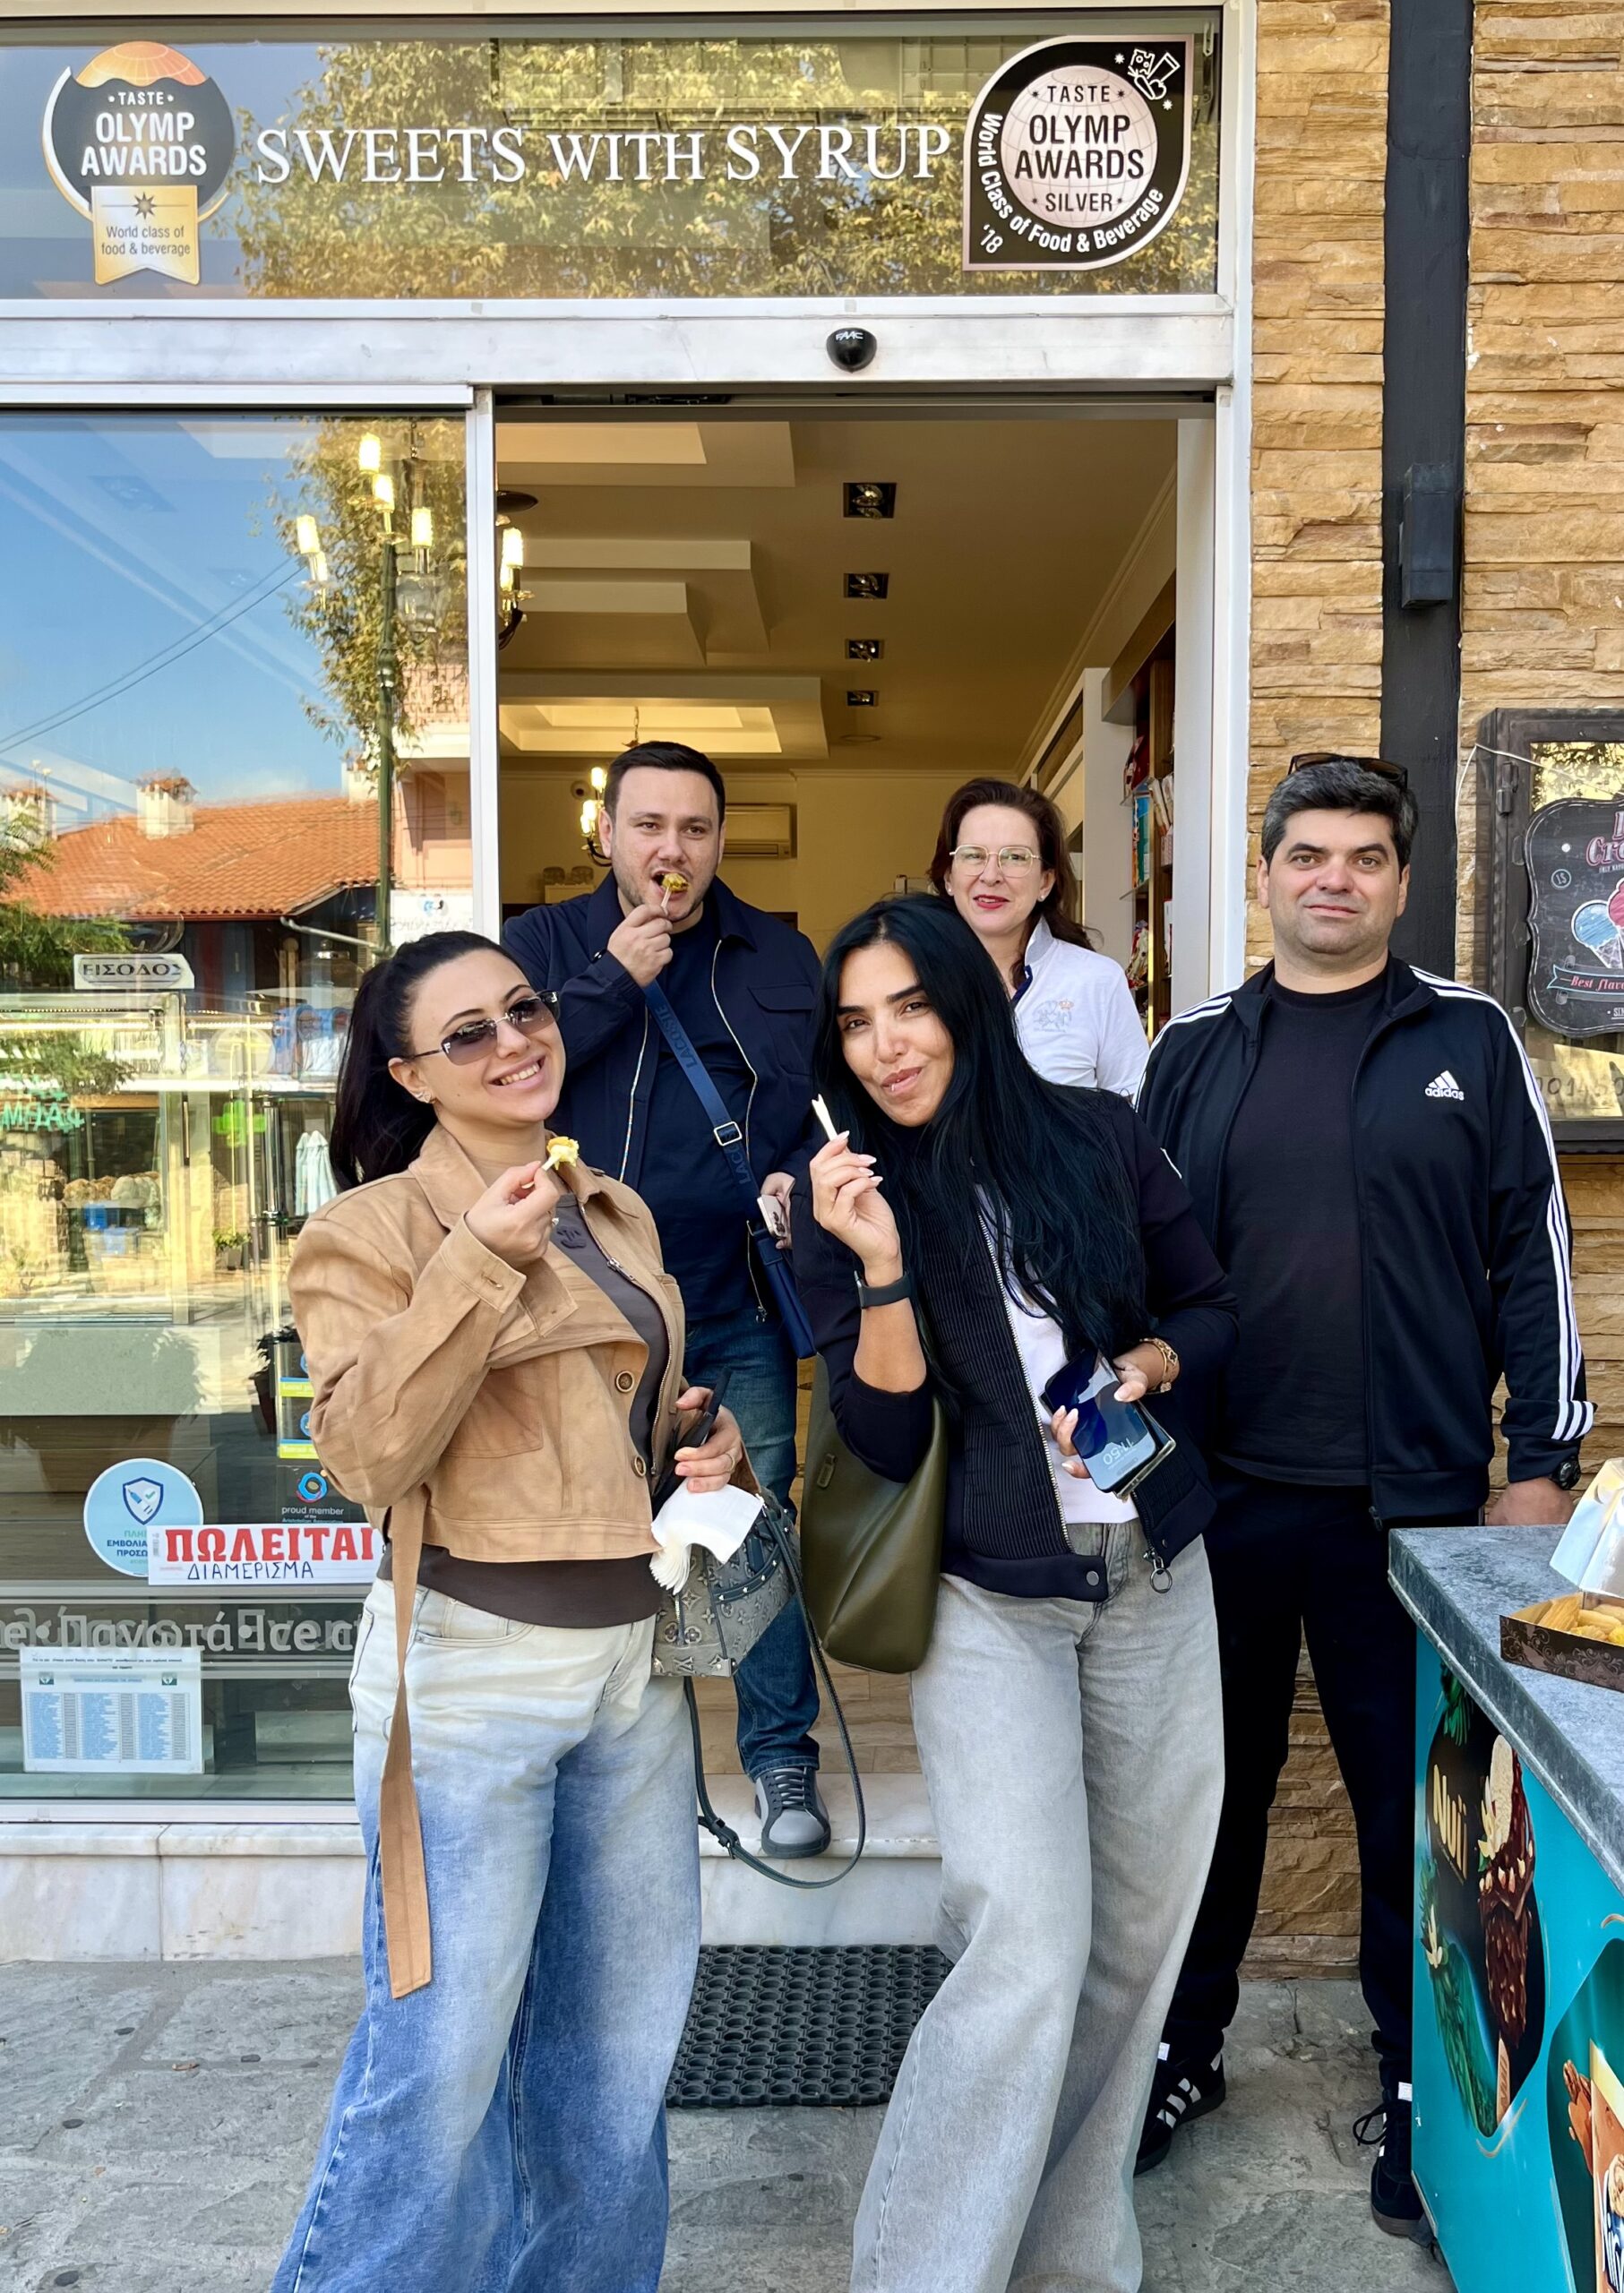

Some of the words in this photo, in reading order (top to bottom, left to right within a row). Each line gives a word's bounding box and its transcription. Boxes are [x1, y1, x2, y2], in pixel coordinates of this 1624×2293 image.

[117, 91, 165, 106] TASTE
[1047, 85, 1111, 103] TASTE
[96, 112, 195, 143] OLYMP
[1029, 115, 1130, 145] OLYMP
[977, 113, 1003, 167] World
[81, 144, 207, 176] AWARDS
[256, 127, 526, 185] SWEETS
[546, 133, 706, 182] WITH
[726, 124, 951, 182] SYRUP
[1014, 149, 1144, 179] AWARDS
[981, 172, 1013, 219] Class
[1045, 193, 1113, 212] SILVER
[1010, 213, 1032, 236] of
[1093, 187, 1164, 250] Beverage
[106, 226, 138, 238] World
[142, 226, 170, 238] class
[174, 226, 185, 238] of
[1028, 224, 1072, 253] Food
[1077, 233, 1090, 253] &
[101, 242, 125, 254] food
[129, 244, 138, 254] &
[141, 242, 191, 257] beverage
[836, 331, 864, 341] FAAC
[1570, 975, 1594, 988] Best
[1425, 1087, 1465, 1101] adidas
[1103, 1438, 1135, 1465] 11:50
[281, 1506, 307, 1516] proud
[308, 1507, 345, 1516] member
[165, 1527, 374, 1562] ΠΩΛΕΙΤΑΙ
[187, 1561, 314, 1580] ΔΙΑΜΕΡΙΣΜΑ
